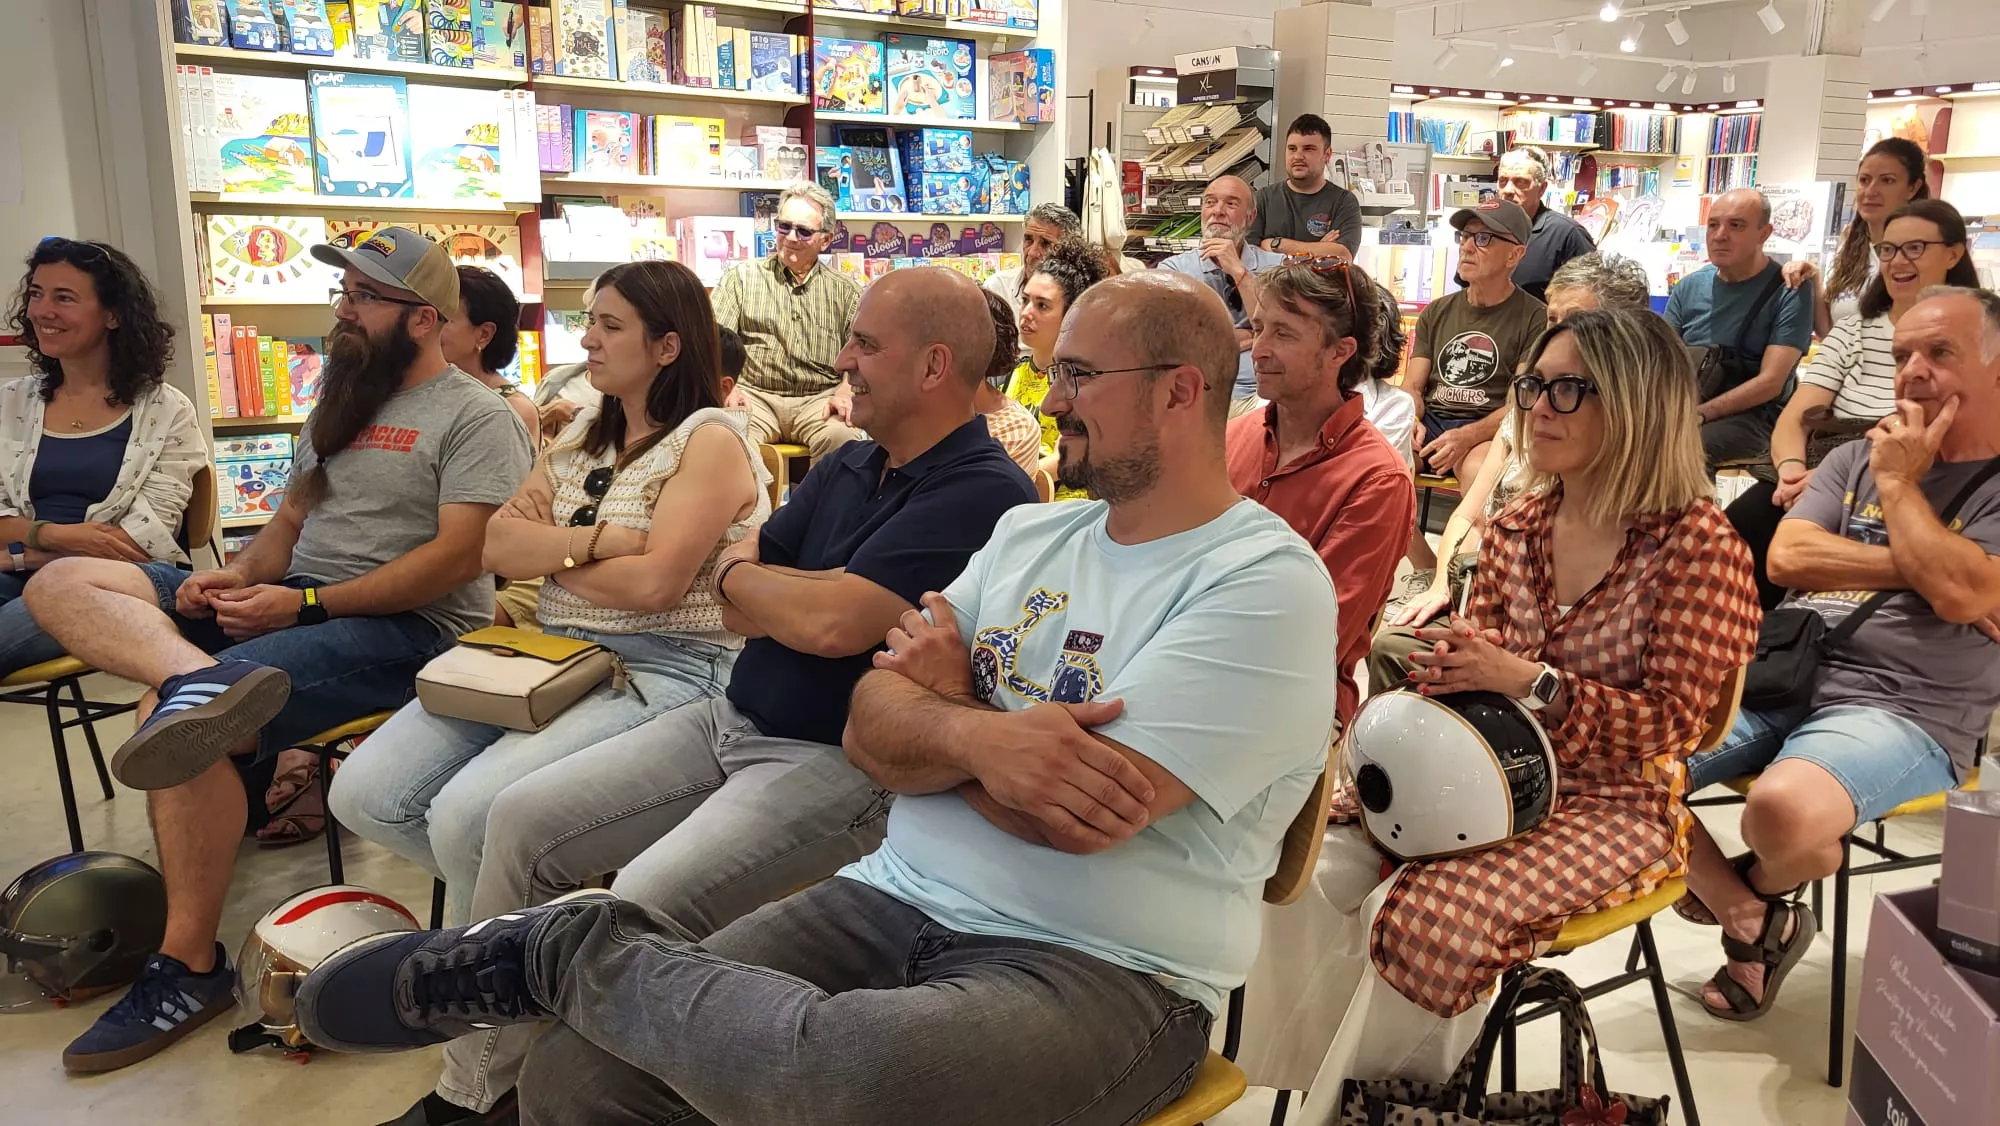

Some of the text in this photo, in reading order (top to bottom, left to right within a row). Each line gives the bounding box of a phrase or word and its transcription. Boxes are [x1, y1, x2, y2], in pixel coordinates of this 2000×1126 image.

[1200, 73, 1213, 93] XL
[867, 238, 901, 256] Bloom
[922, 241, 956, 257] Bloom
[974, 234, 1000, 248] Bloom
